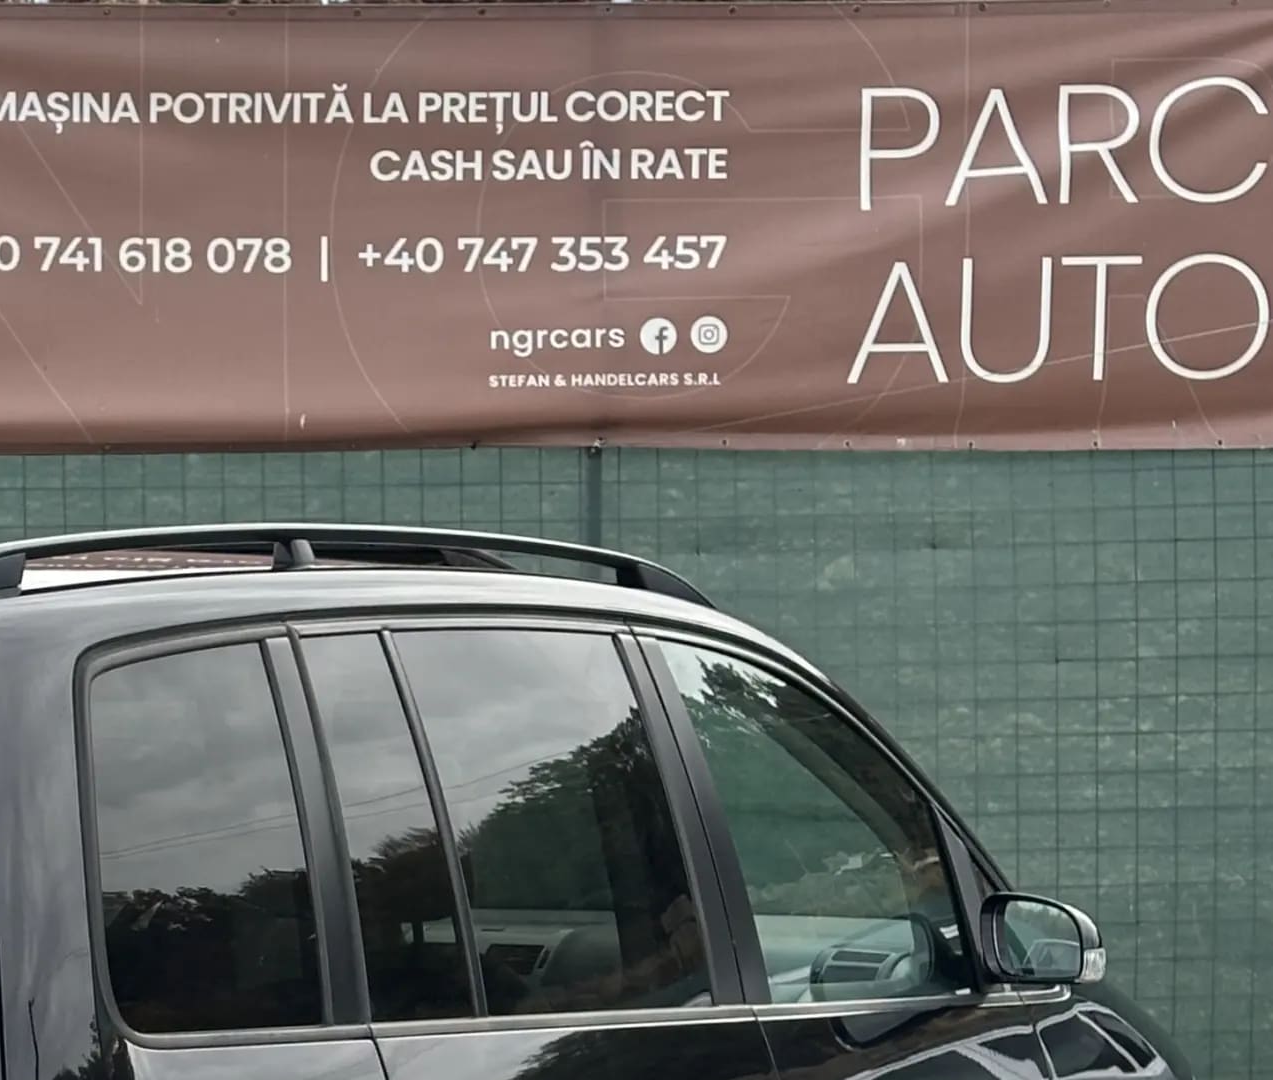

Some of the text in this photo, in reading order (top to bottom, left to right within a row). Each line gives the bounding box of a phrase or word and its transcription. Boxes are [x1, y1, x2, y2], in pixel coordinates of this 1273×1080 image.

[148, 83, 355, 125] POTRIVITĂ
[362, 91, 410, 124] LA
[417, 90, 559, 135] PREȚUL
[564, 89, 731, 123] CORECT
[369, 140, 728, 182] CASH SAU ÎN RATE
[859, 76, 1270, 212] PARC
[33, 236, 104, 273] 741
[118, 236, 193, 274] 618
[205, 236, 293, 274] 078
[357, 235, 445, 274] +40
[456, 235, 539, 274] 747
[549, 235, 630, 273] 353
[642, 234, 728, 271] 457
[845, 252, 1271, 385] AUTO
[489, 326, 626, 358] ngrcars
[488, 373, 551, 389] STEFAN
[553, 373, 567, 388] &
[570, 372, 680, 388] HANDELCARS
